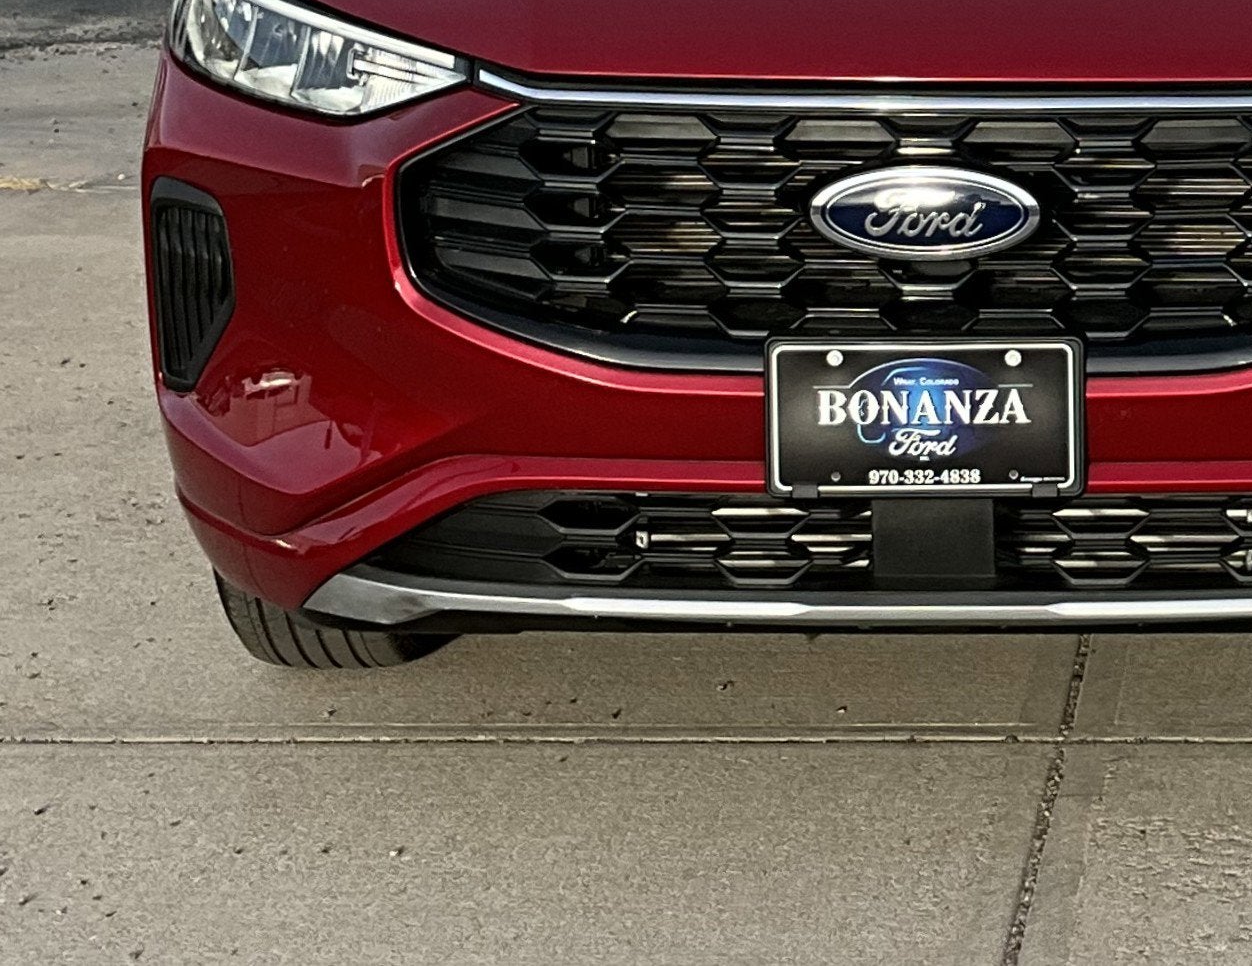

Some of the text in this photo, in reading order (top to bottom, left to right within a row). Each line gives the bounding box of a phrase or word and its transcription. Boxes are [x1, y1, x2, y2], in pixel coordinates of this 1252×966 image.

[864, 188, 987, 238] Ford
[817, 388, 1032, 426] BONANZA
[888, 427, 959, 456] Ford
[868, 469, 982, 485] 970-332-4838
